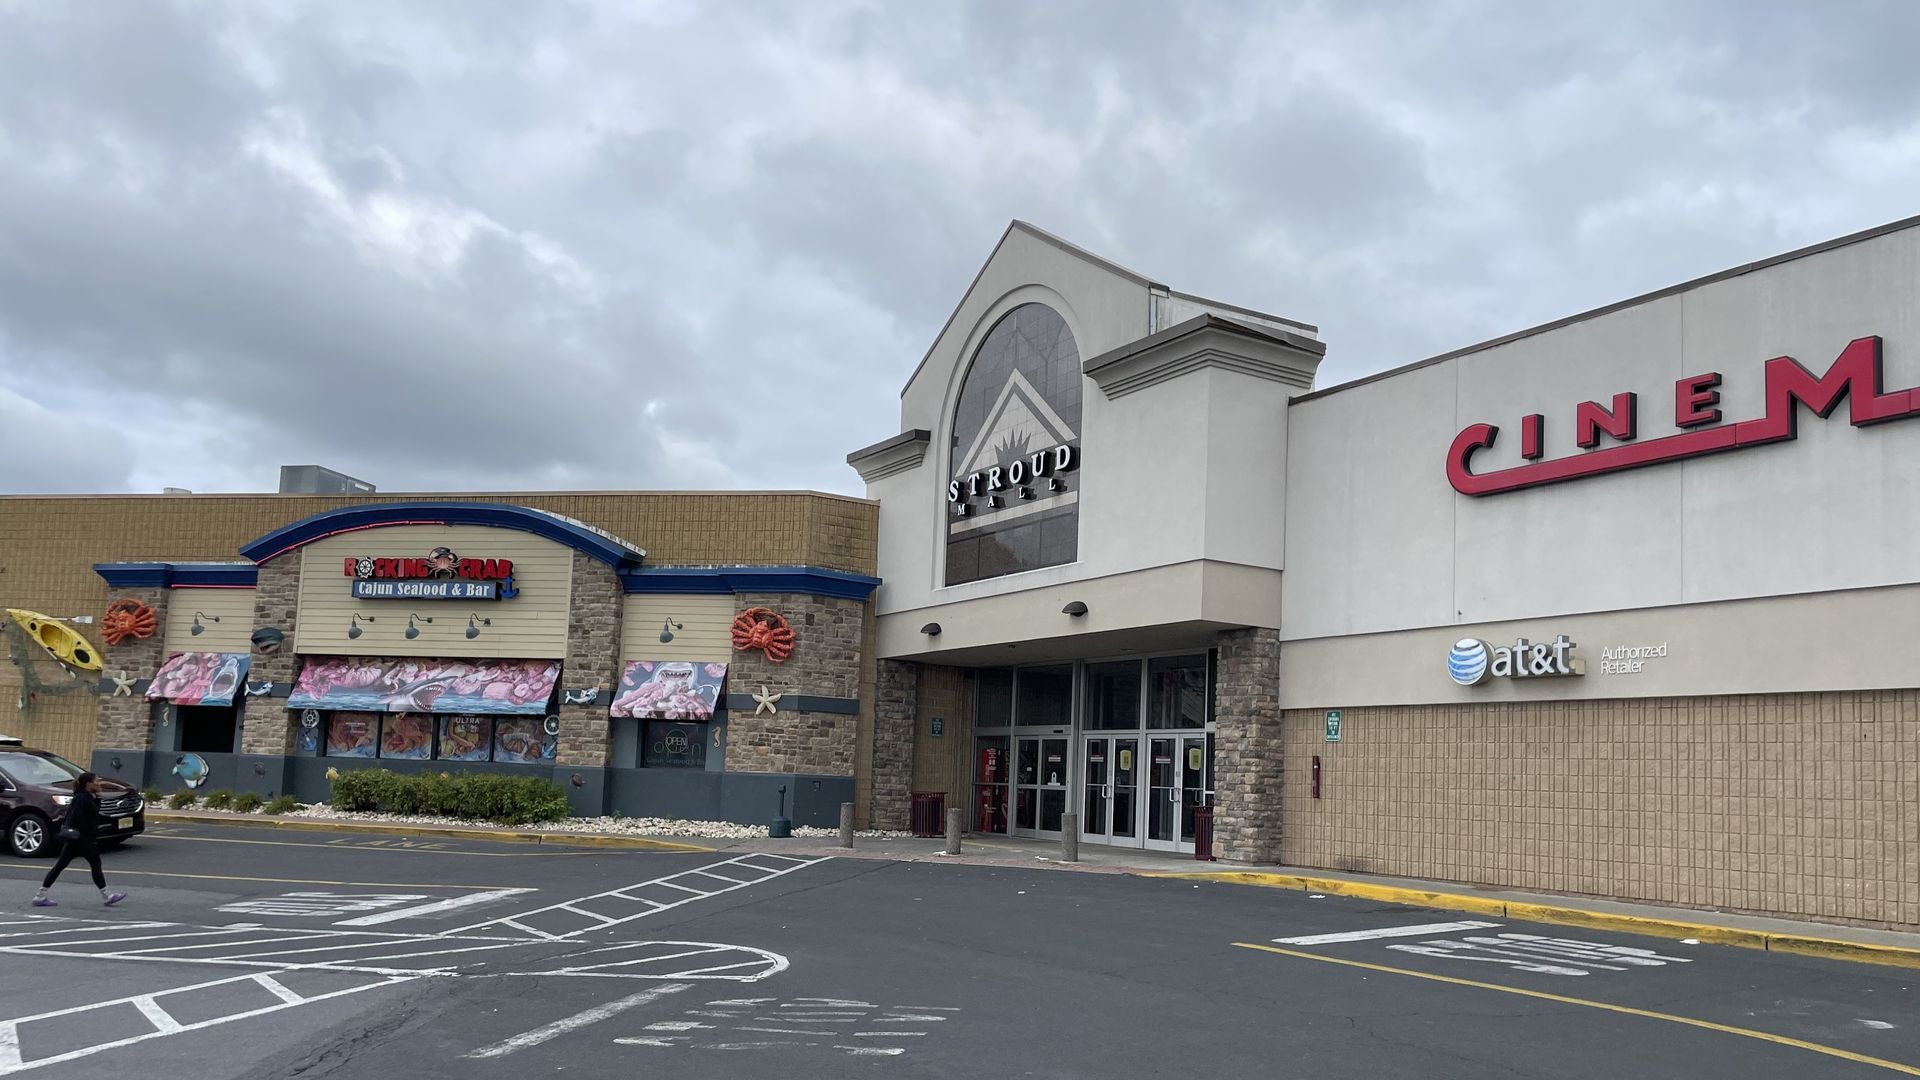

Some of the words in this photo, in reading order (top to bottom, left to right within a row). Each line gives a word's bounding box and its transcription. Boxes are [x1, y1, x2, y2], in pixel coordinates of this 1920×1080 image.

[948, 444, 1073, 503] STROUD
[957, 478, 1058, 516] MALL
[459, 558, 514, 580] CRAB
[358, 581, 394, 596] Cajun
[397, 582, 447, 596] Seafood
[451, 583, 462, 596] &
[465, 583, 490, 597] Bar
[1491, 634, 1576, 678] at&t
[1601, 642, 1668, 661] Authorized
[1600, 658, 1645, 676] Retailer
[455, 716, 480, 724] ULTRA
[666, 736, 686, 746] OPEN
